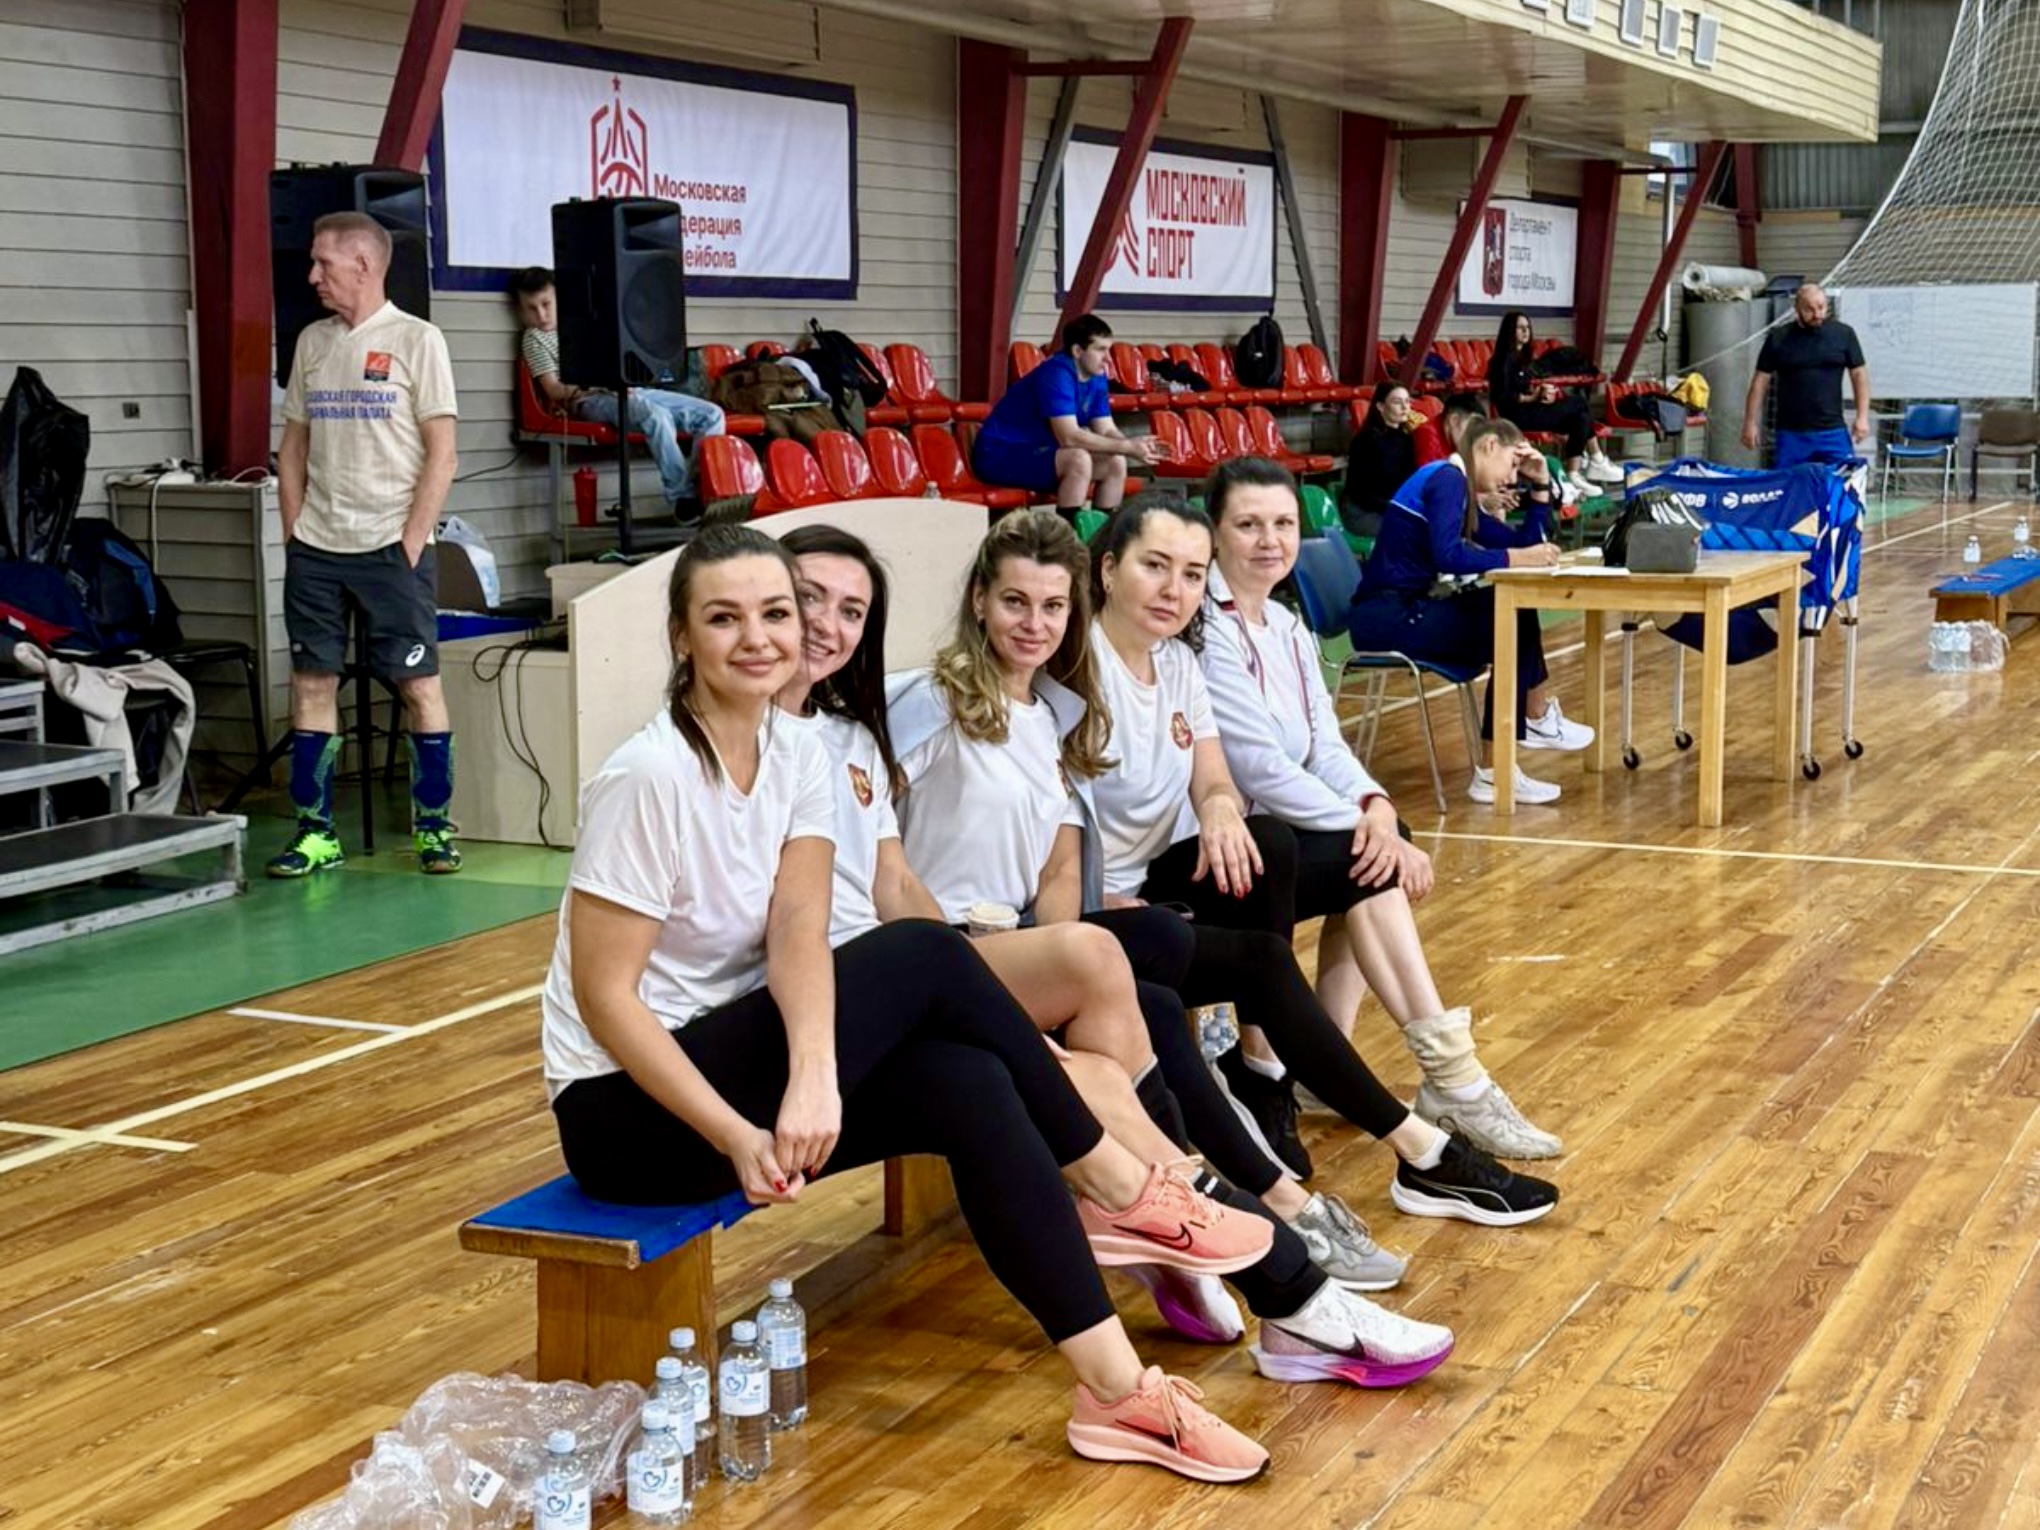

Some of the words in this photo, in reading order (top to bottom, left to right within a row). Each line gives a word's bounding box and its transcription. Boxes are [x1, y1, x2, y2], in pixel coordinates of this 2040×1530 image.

[654, 173, 747, 203] Московская
[1146, 167, 1246, 227] МОСКОВСКИЙ
[680, 215, 742, 239] дерация
[684, 245, 737, 268] ейбола
[1146, 227, 1194, 279] СПОРТ
